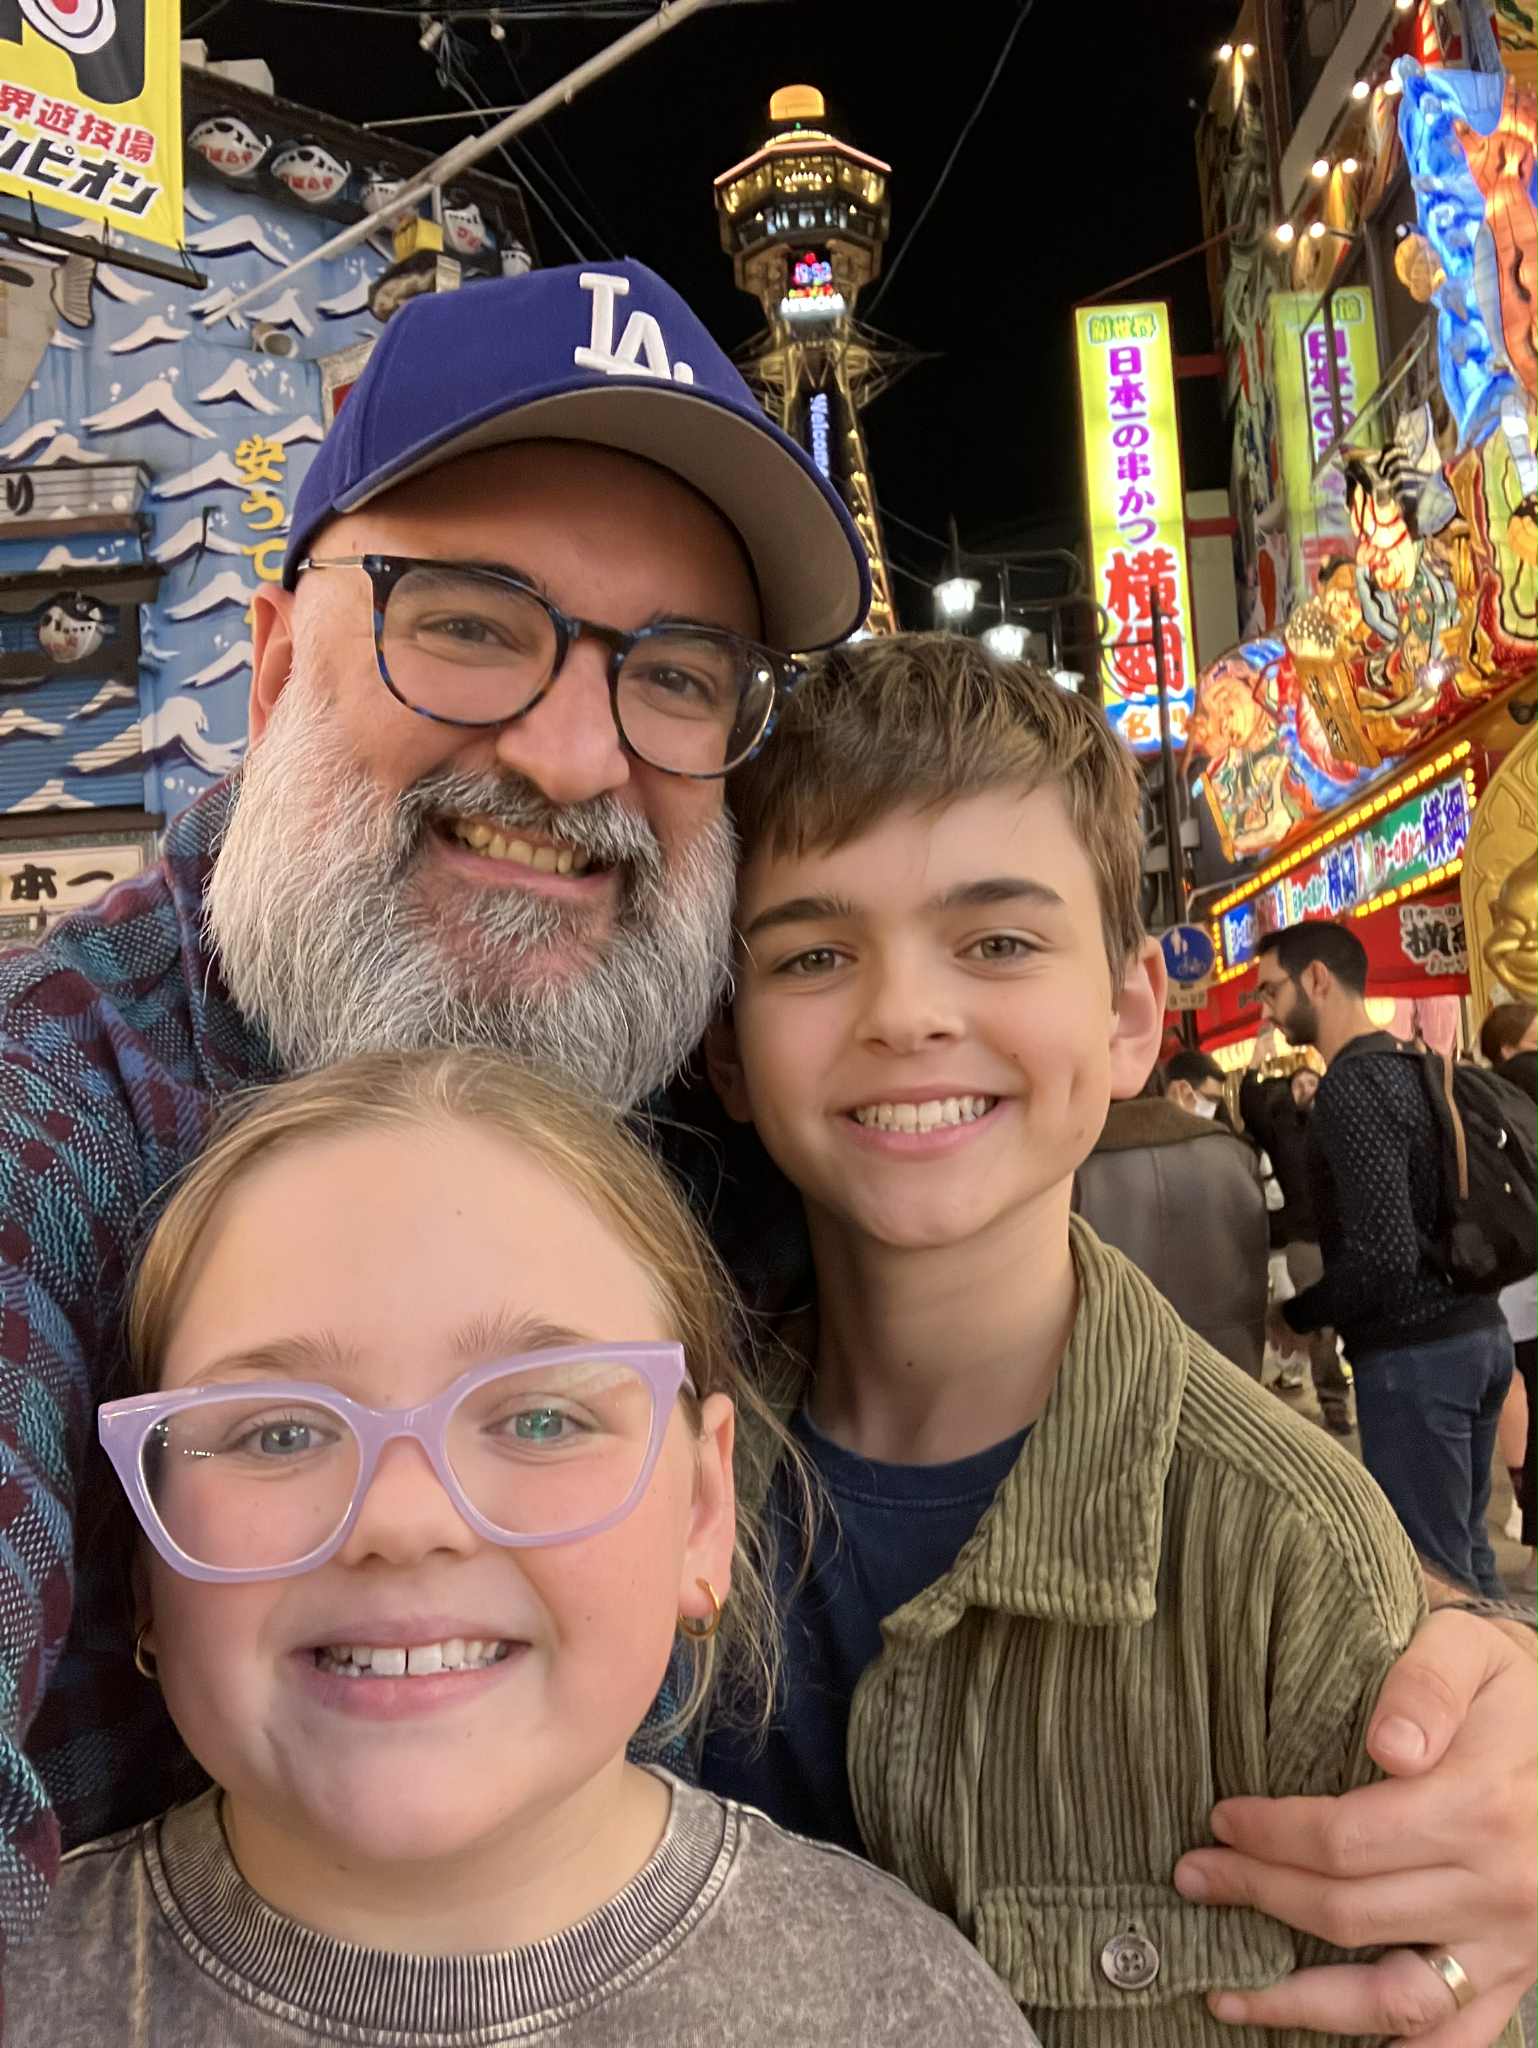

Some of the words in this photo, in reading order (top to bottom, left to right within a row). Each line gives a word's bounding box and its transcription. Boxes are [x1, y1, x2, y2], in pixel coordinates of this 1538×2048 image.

[0, 84, 155, 164] 界遊技場
[0, 125, 158, 215] ンピオン
[575, 272, 693, 385] LA
[1108, 346, 1158, 545] 日本一の串かつ
[1307, 329, 1355, 452] 日本一の
[235, 434, 288, 625] 安うて
[1105, 547, 1185, 700] 横綱
